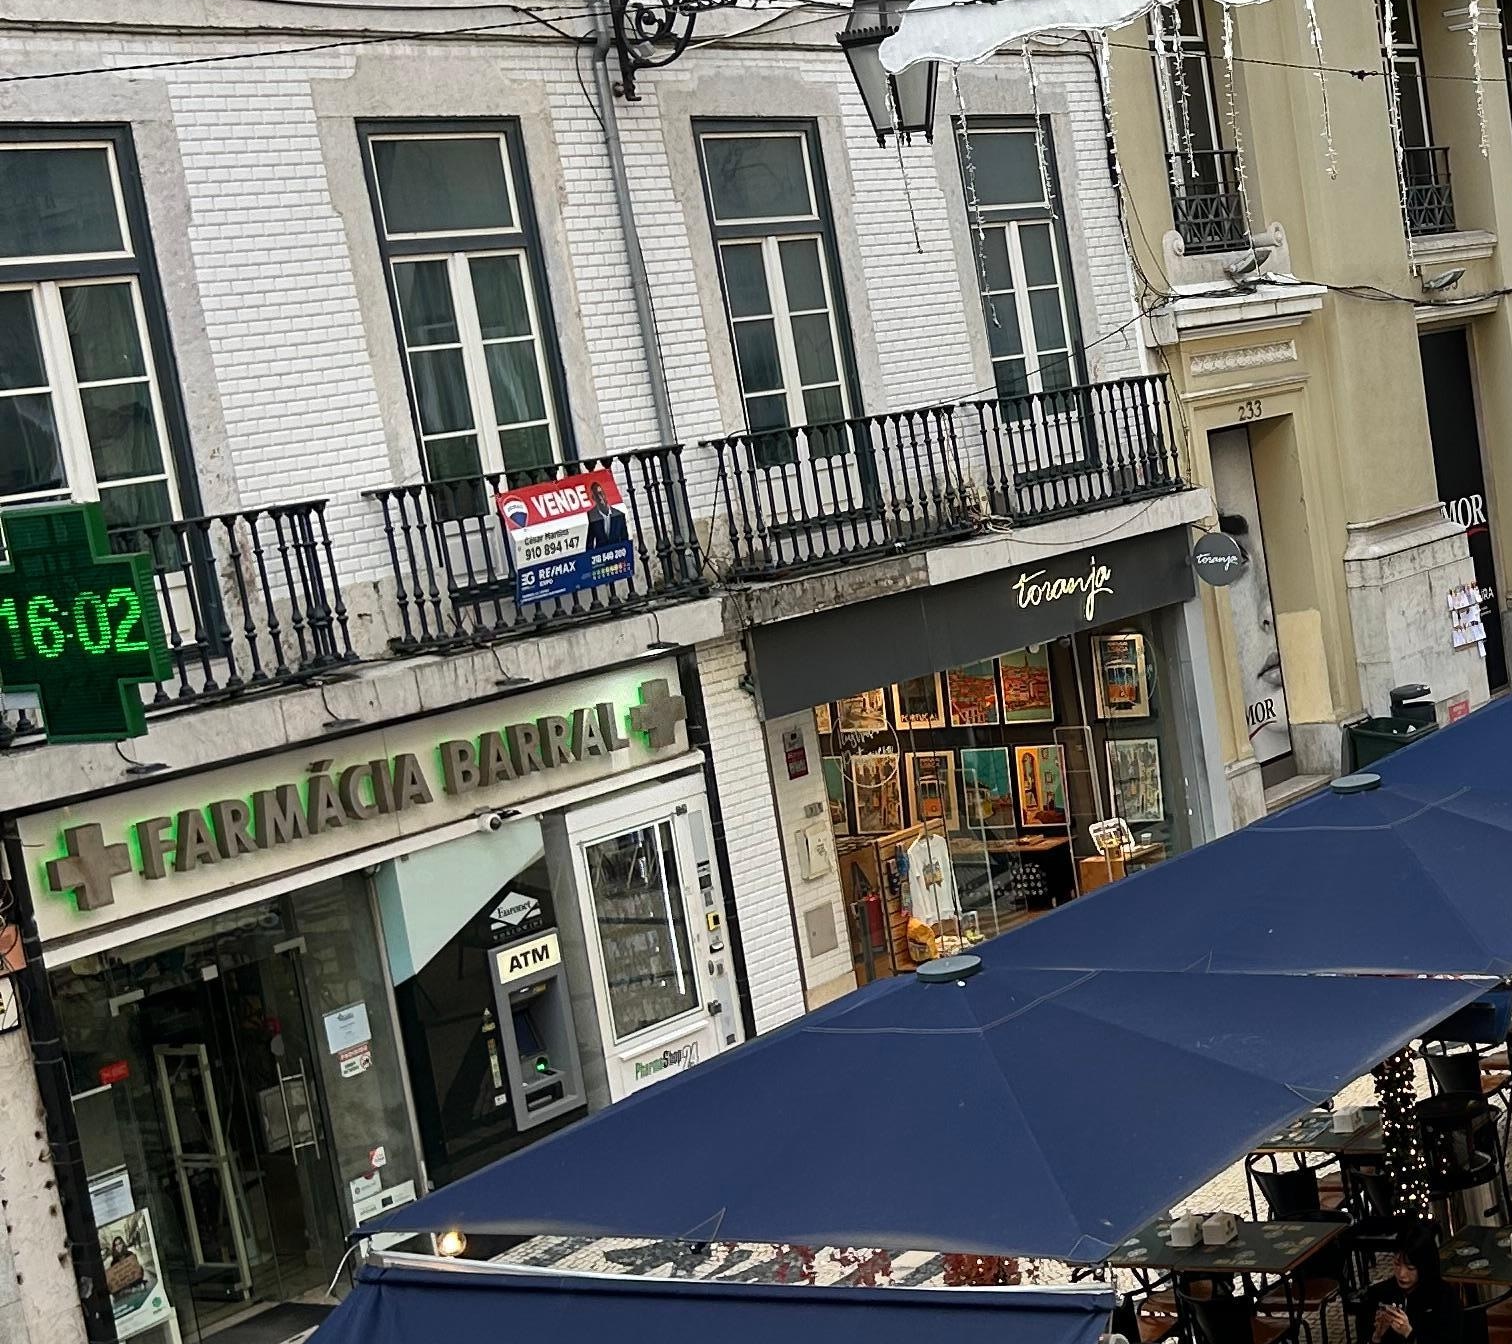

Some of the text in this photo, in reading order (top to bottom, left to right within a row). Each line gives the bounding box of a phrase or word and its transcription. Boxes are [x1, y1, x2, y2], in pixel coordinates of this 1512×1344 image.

[1238, 400, 1262, 421] 233
[531, 485, 592, 519] VENDE
[525, 536, 580, 561] 910 894 147
[1196, 552, 1239, 571] toranja
[538, 561, 576, 580] RE/MAX
[1012, 556, 1114, 622] toranja
[0, 587, 150, 660] 16:02
[135, 701, 631, 880] FARMÁCIA BARRAL
[509, 943, 550, 973] ATM
